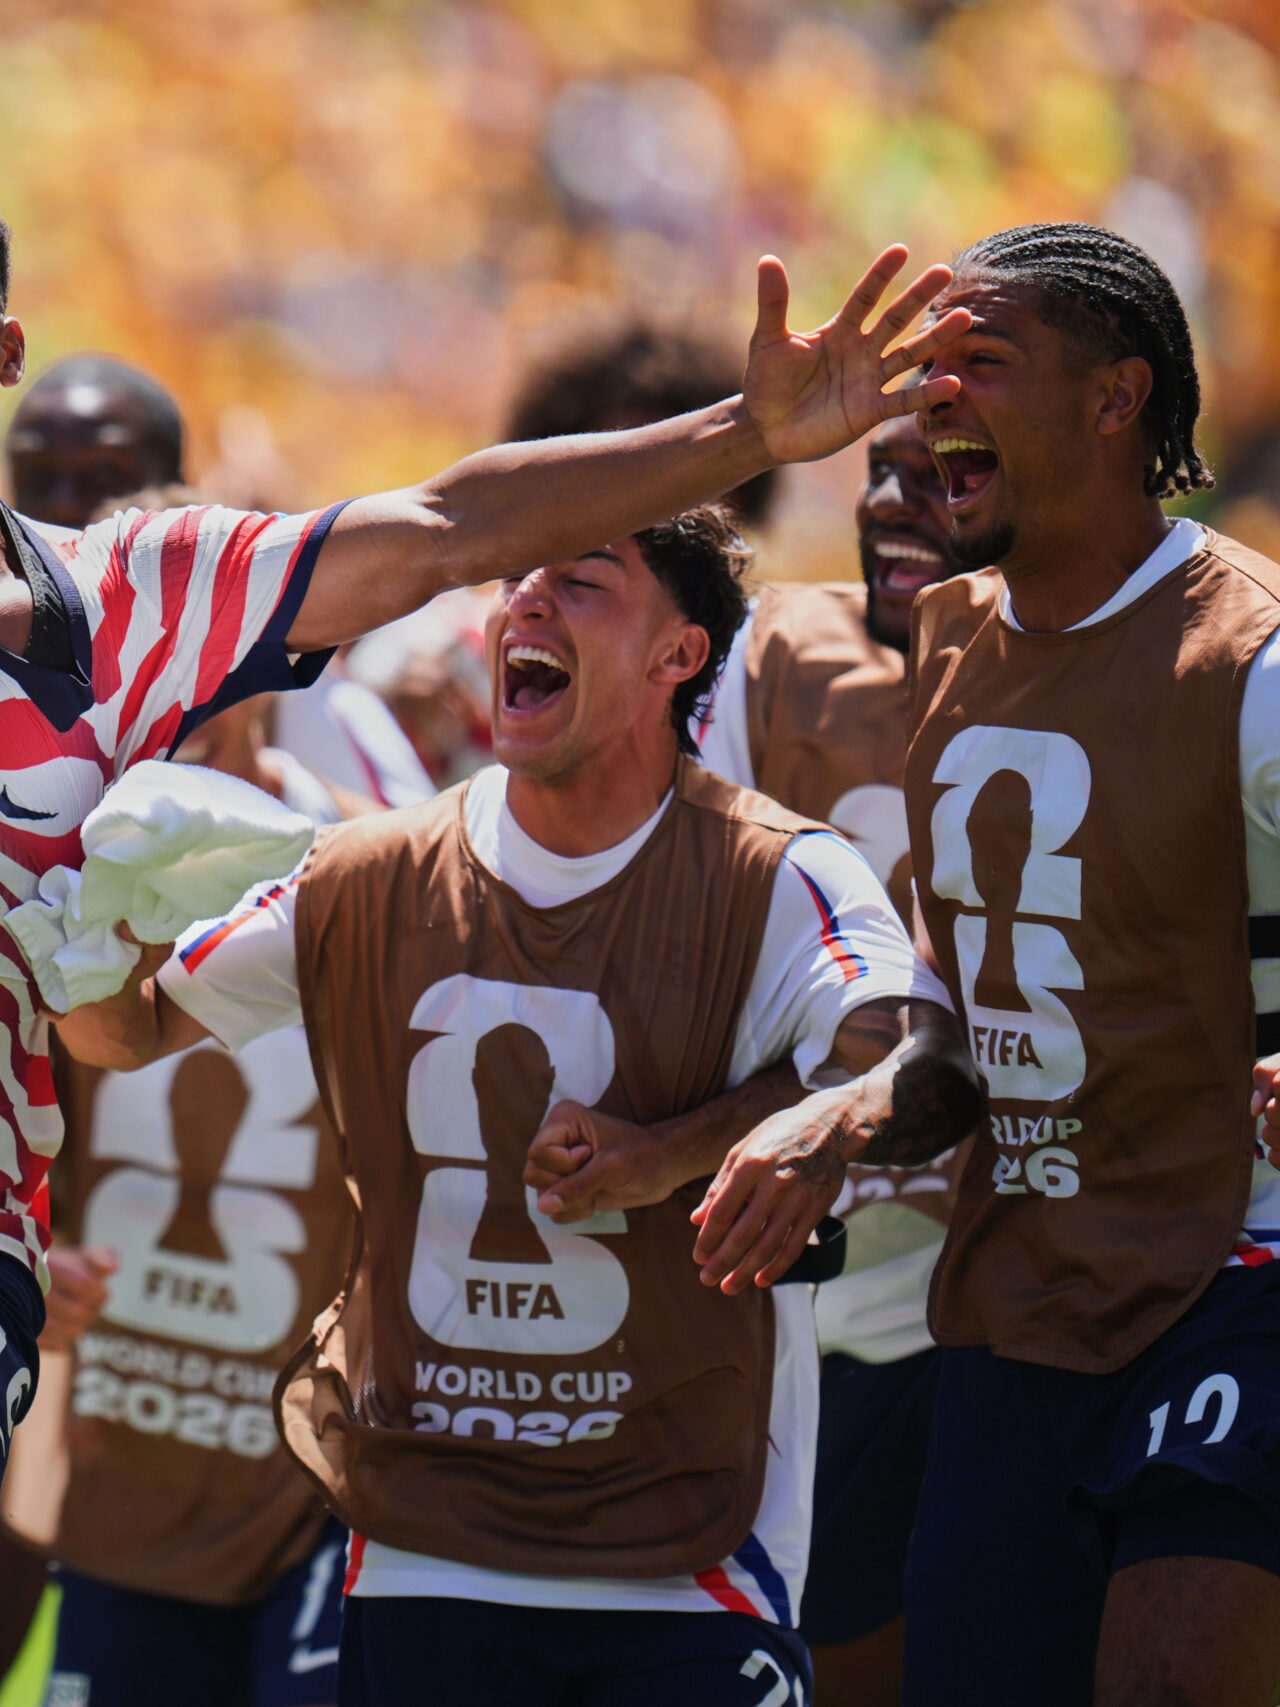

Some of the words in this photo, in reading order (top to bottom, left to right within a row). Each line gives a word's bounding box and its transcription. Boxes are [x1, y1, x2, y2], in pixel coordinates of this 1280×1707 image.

[972, 1024, 1045, 1070] FIFA
[144, 1266, 240, 1319] FIFA
[465, 1278, 566, 1321] FIFA
[549, 1370, 634, 1403] CUP
[73, 1366, 280, 1460] 2026
